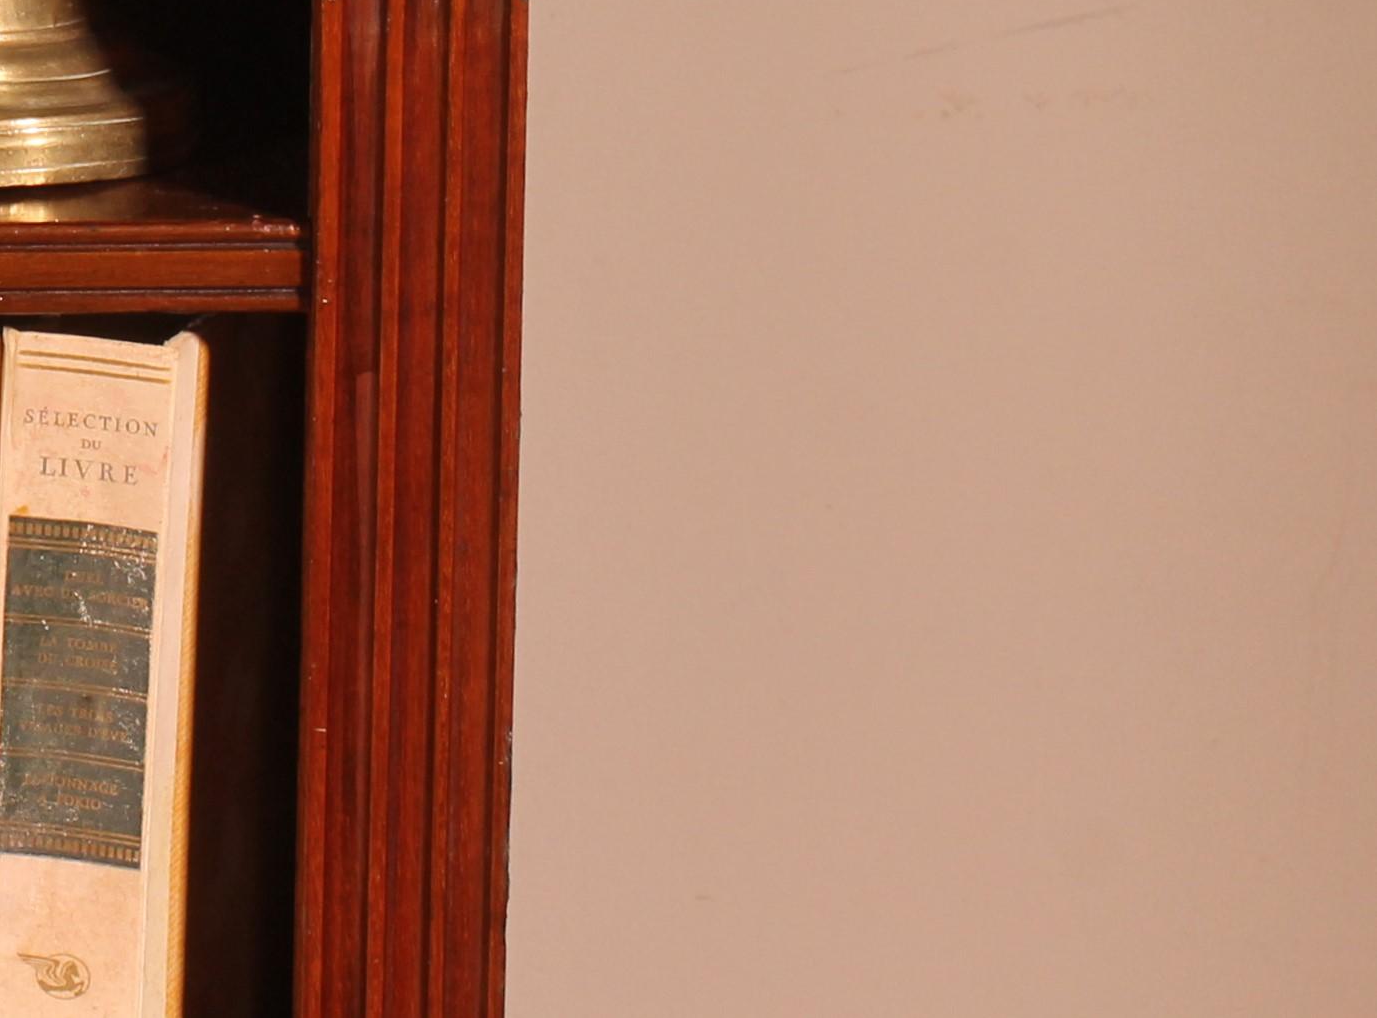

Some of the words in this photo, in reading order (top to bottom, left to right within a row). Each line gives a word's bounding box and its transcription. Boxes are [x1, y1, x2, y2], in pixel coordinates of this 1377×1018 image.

[24, 407, 159, 439] SÉLECTION
[79, 438, 102, 452] DU
[37, 455, 139, 486] LIVRE
